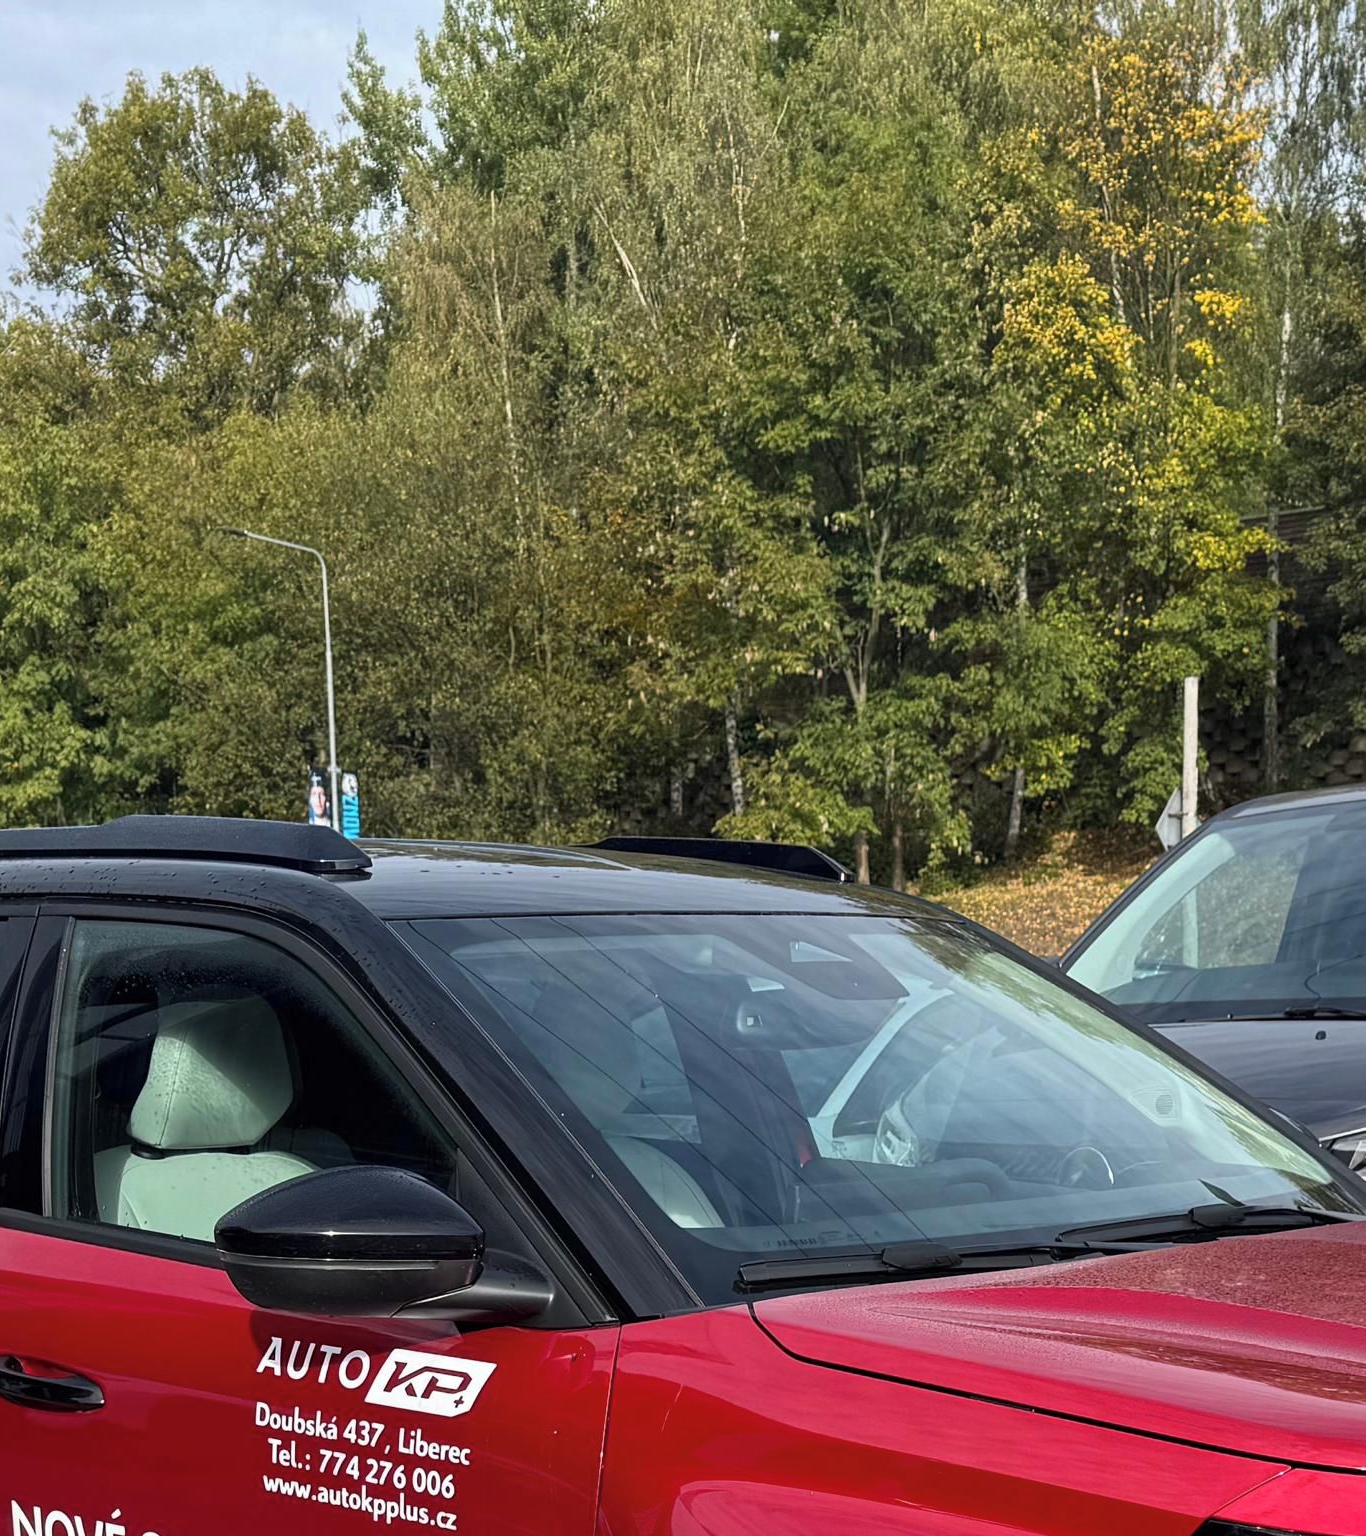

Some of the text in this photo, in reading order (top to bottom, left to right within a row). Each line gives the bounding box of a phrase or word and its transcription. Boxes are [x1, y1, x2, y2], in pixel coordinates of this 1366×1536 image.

[256, 1336, 371, 1389] AUTO
[255, 1402, 338, 1440] Doubská
[399, 1427, 471, 1466] Liberec
[267, 1438, 455, 1499] Tel.: 774 276 006
[263, 1475, 458, 1531] www.autokpplus.cz
